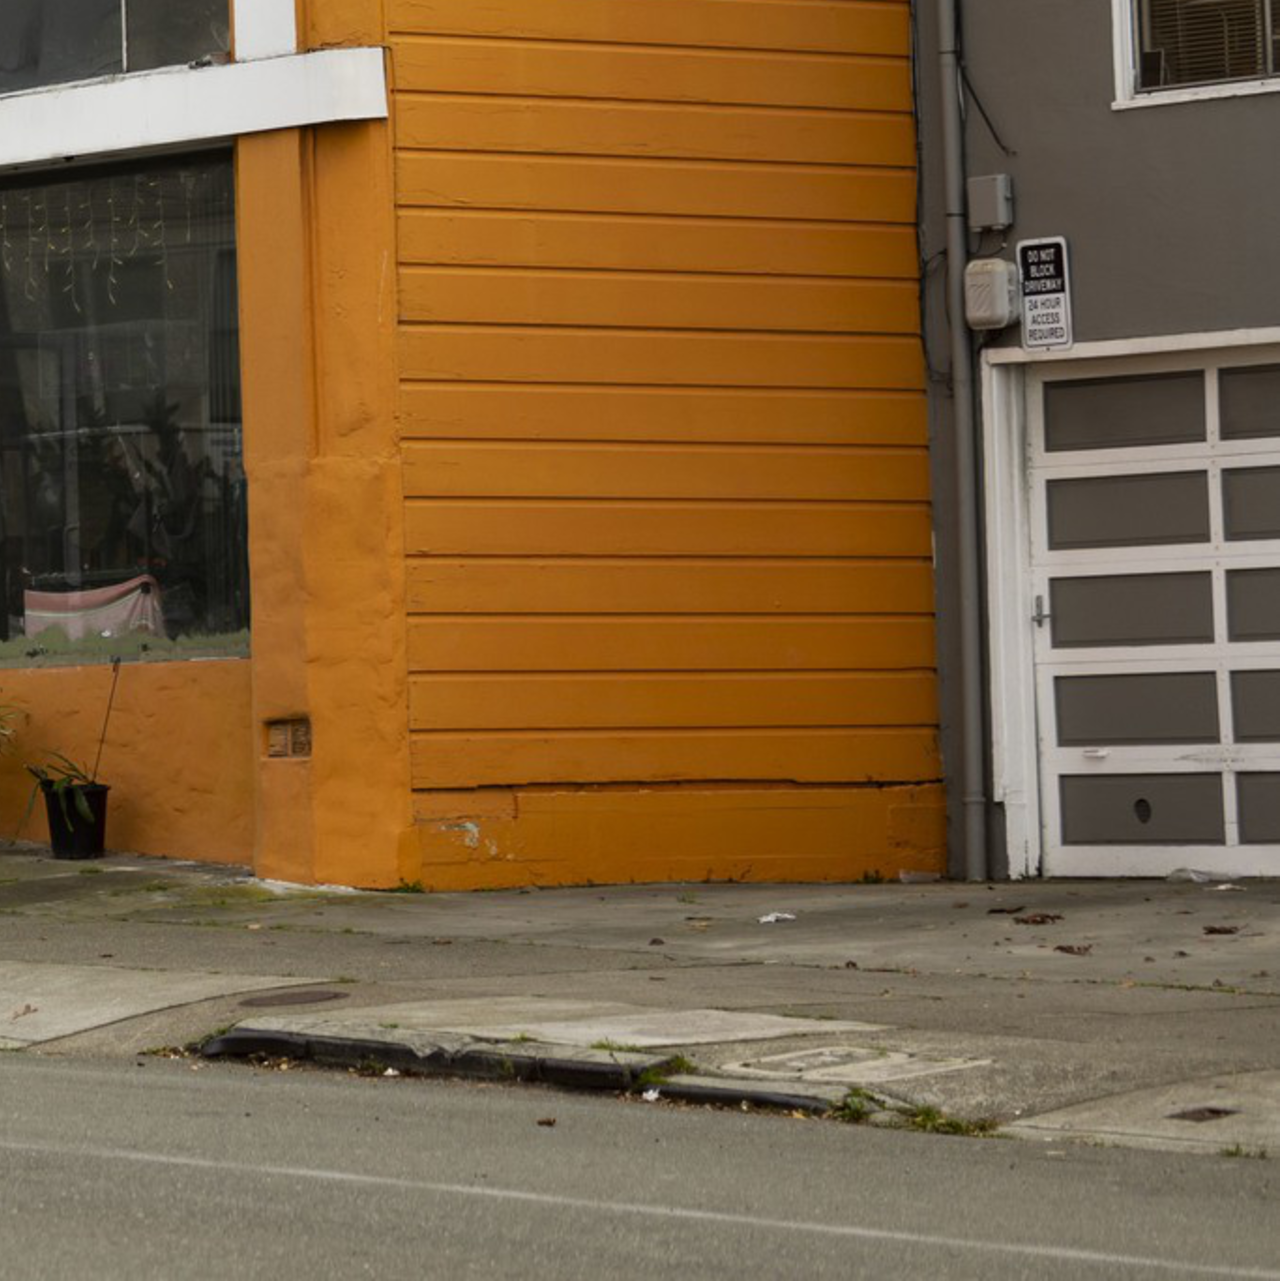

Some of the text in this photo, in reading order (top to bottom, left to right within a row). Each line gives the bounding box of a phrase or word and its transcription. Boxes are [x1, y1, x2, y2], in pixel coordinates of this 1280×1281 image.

[1026, 248, 1056, 263] DO NOT
[1029, 263, 1056, 278] BLOCK
[1024, 278, 1063, 293] DRIVEWAY
[1028, 296, 1061, 311] 24 HOUR
[1030, 312, 1060, 326] ACCESS
[1028, 326, 1066, 341] REQUIRED
